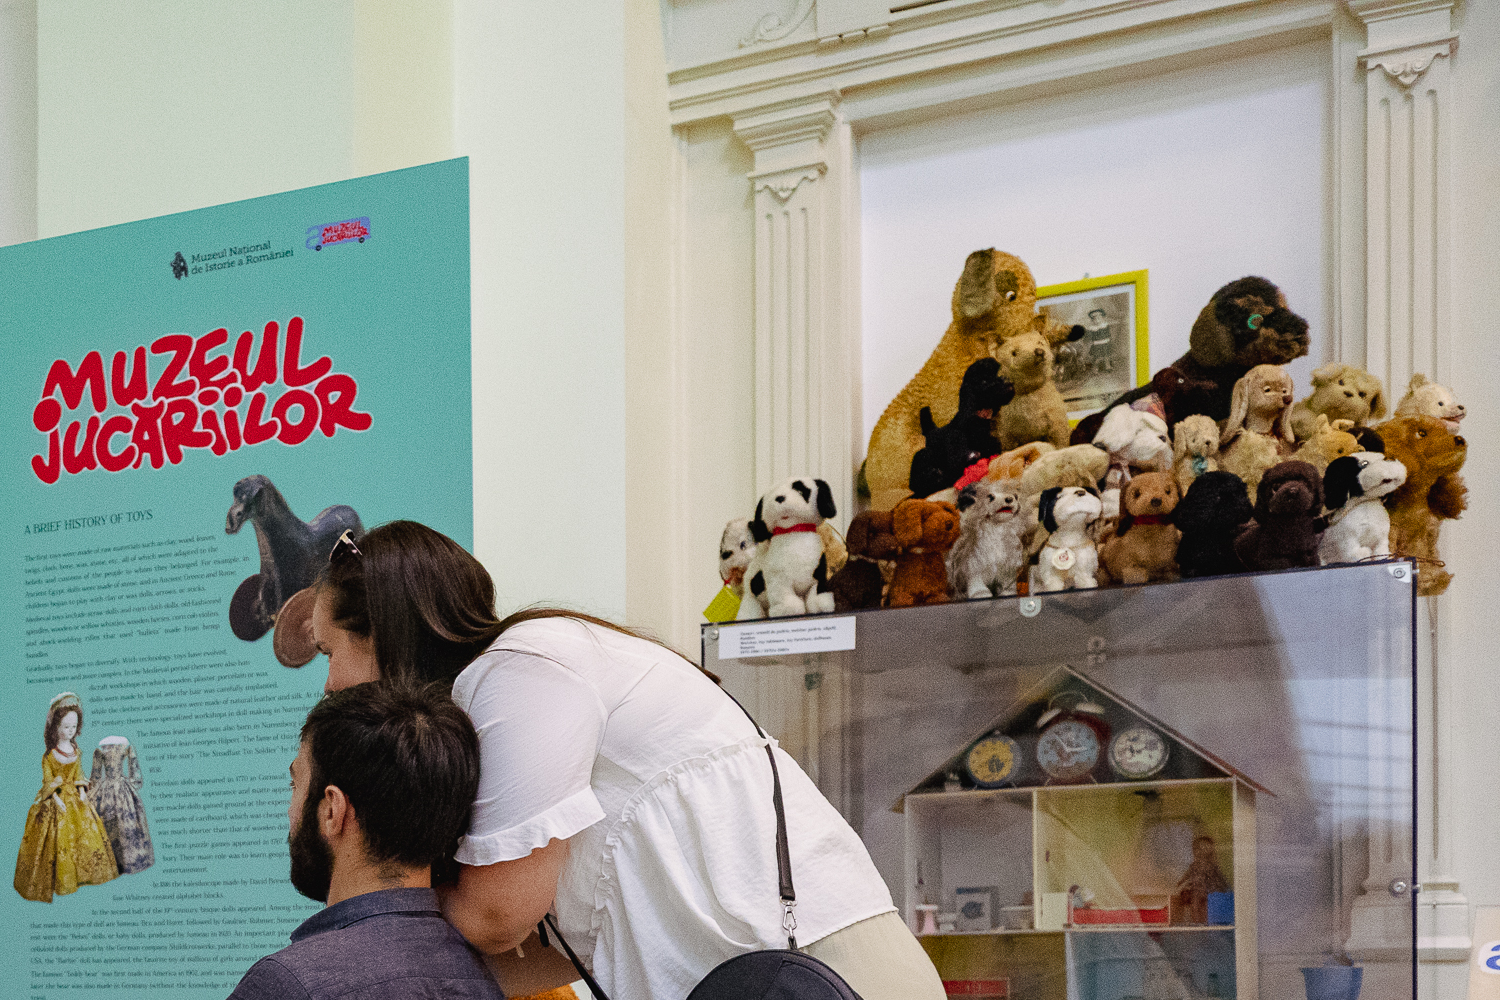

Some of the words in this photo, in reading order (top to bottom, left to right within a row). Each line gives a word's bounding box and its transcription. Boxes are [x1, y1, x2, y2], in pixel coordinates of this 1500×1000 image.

[191, 248, 227, 264] Muzeul
[191, 264, 203, 275] de
[205, 259, 236, 273] Istorie
[245, 249, 295, 266] României
[42, 316, 332, 413] MUZEUL
[22, 523, 32, 535] A
[32, 519, 62, 535] BRIEF
[63, 513, 108, 531] HISTORY
[108, 511, 124, 525] OF
[124, 507, 154, 523] TOYS
